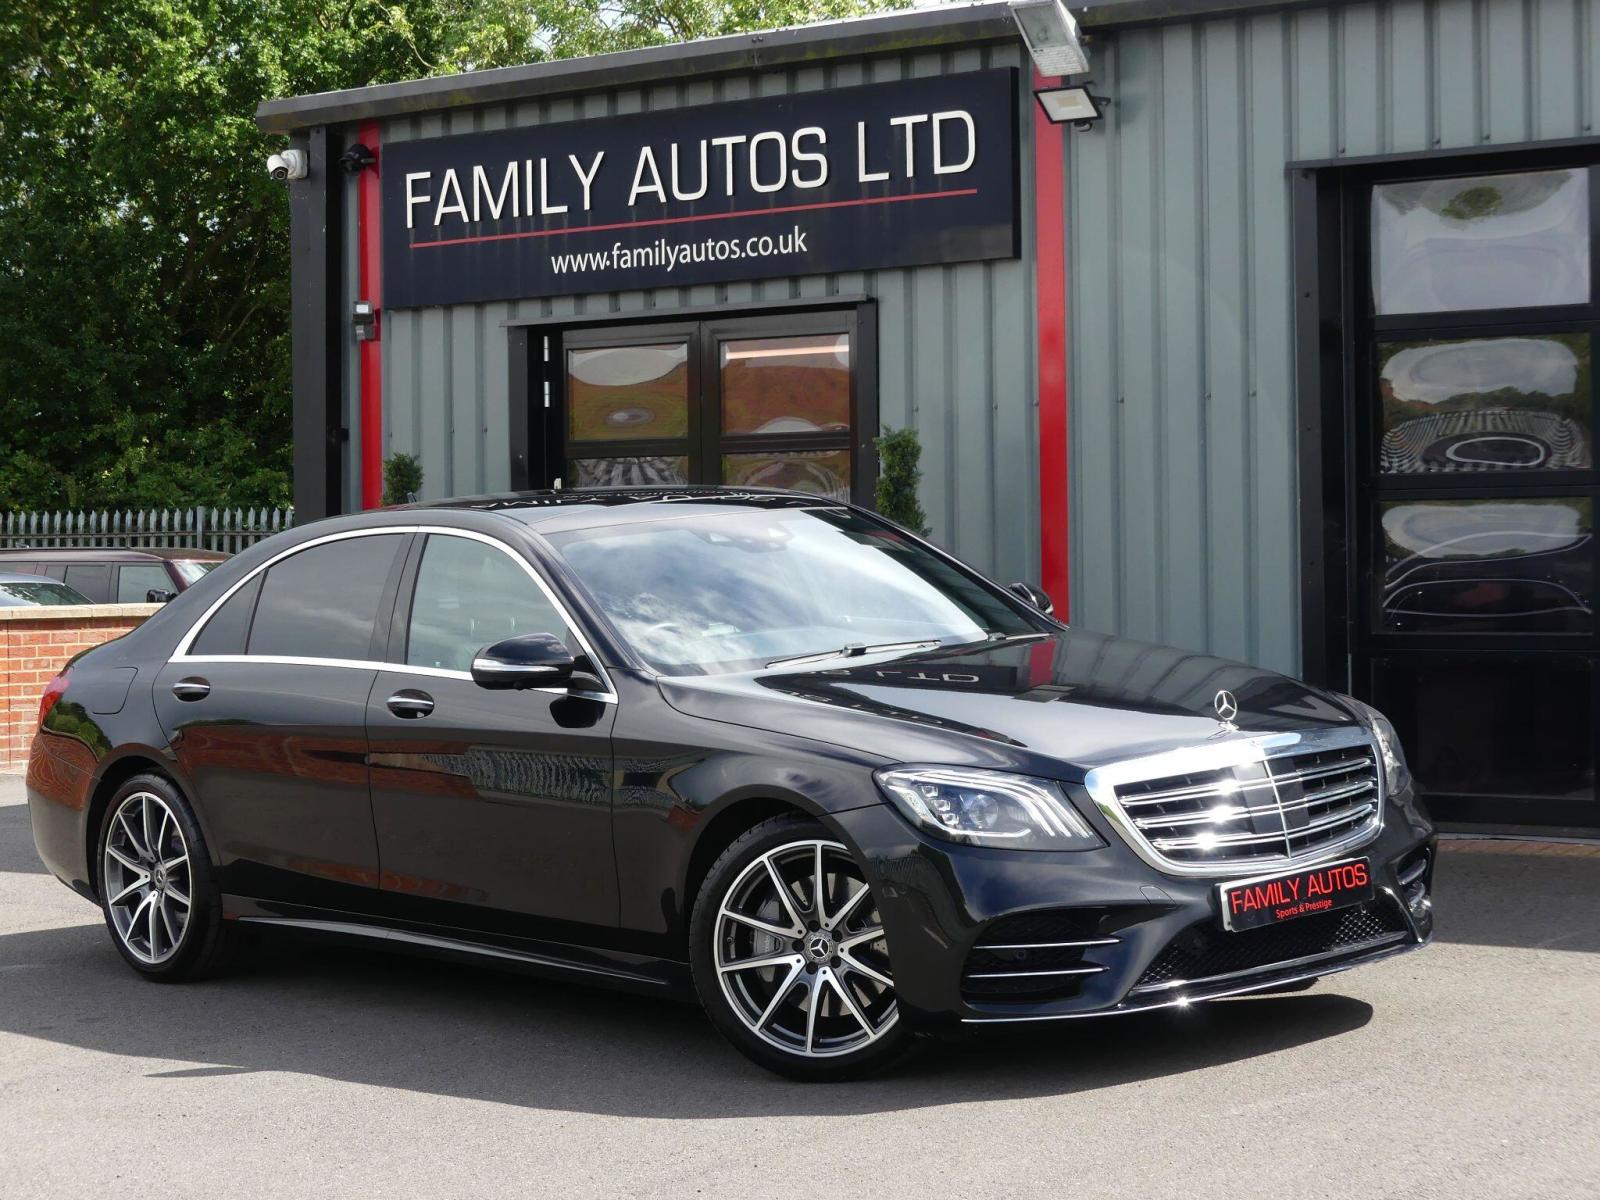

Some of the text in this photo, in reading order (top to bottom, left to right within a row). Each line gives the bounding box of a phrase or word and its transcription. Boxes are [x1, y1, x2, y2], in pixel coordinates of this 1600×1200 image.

[406, 109, 976, 228] FAMILY AUTOS LTD
[550, 226, 808, 275] www.familyautos.co.uk
[1231, 864, 1368, 914] FAMILY AUTOS
[1275, 899, 1333, 919] Sports & Prestige
